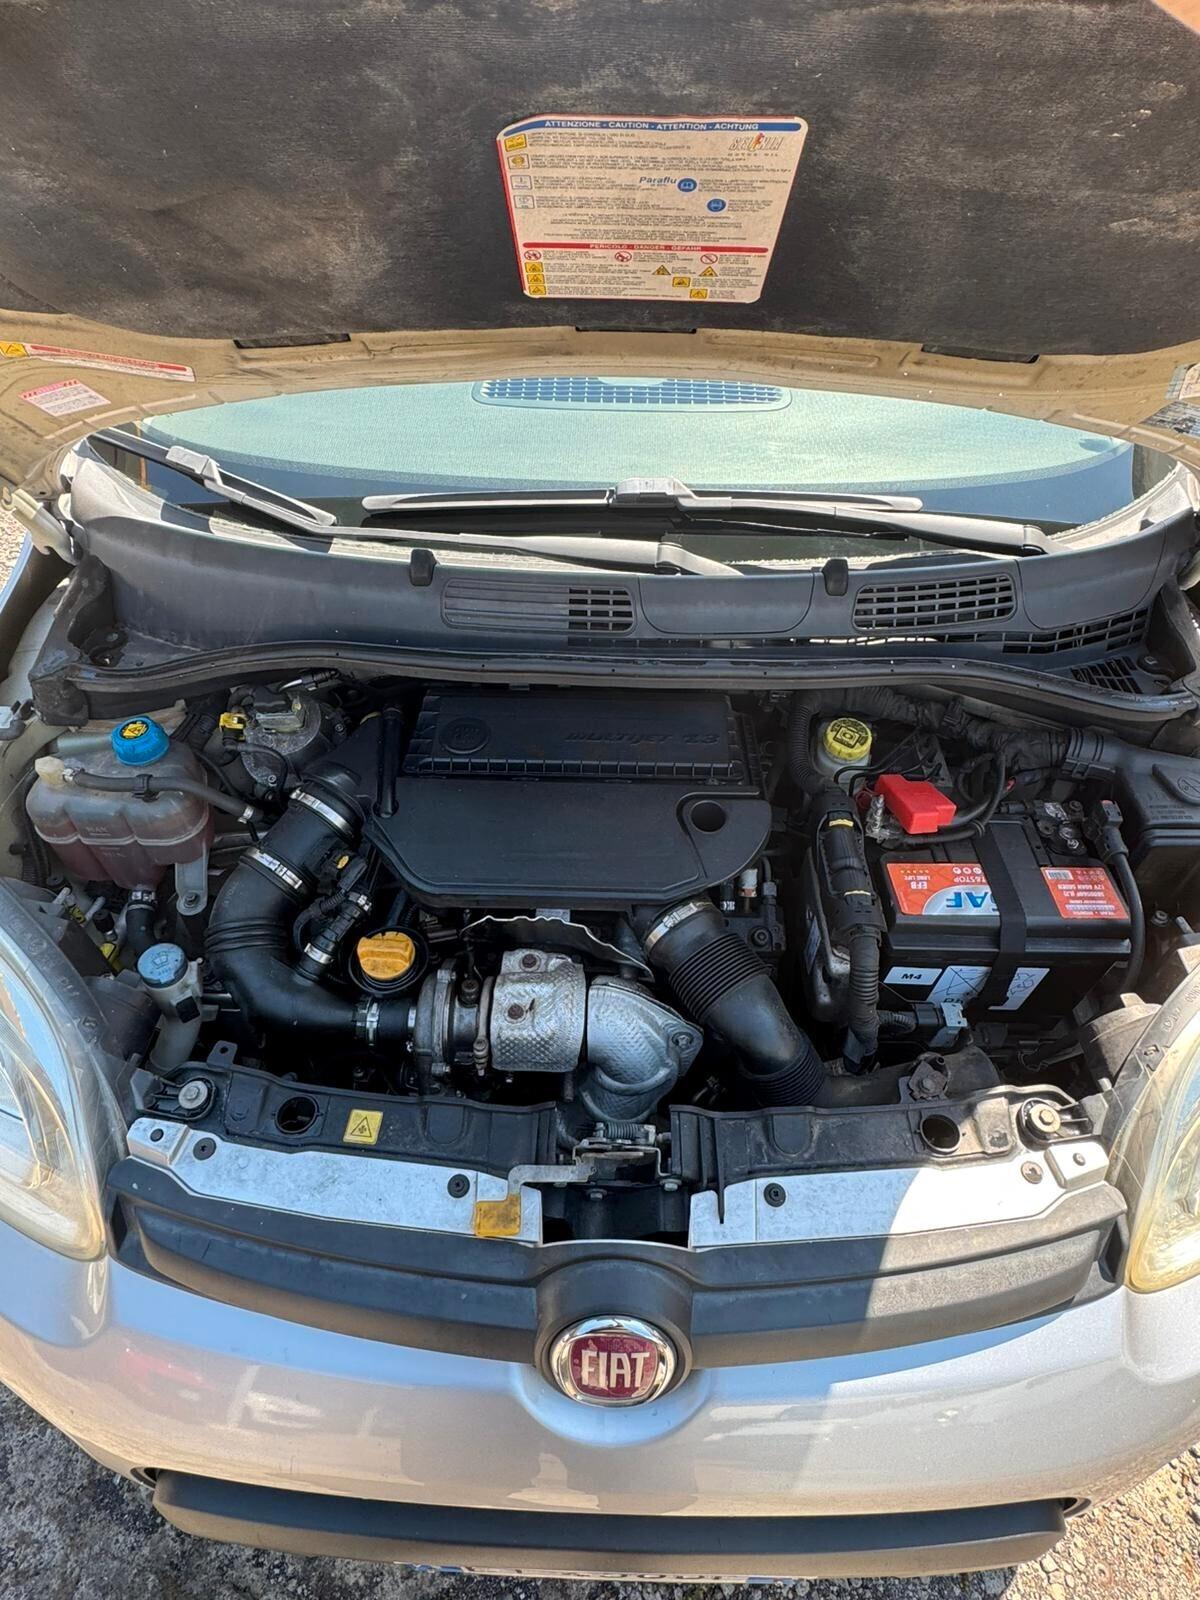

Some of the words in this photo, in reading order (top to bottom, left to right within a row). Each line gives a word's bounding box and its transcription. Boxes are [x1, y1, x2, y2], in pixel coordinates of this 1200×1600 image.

[545, 120, 600, 128] ATTENZIONE
[608, 121, 649, 129] CAUTION
[656, 122, 707, 130] ATTENTION
[714, 122, 759, 130] ACHTUNG
[639, 176, 677, 185] Paraflu
[910, 881, 928, 890] EFB
[946, 892, 999, 912] AF
[581, 1349, 650, 1389] FIAT
